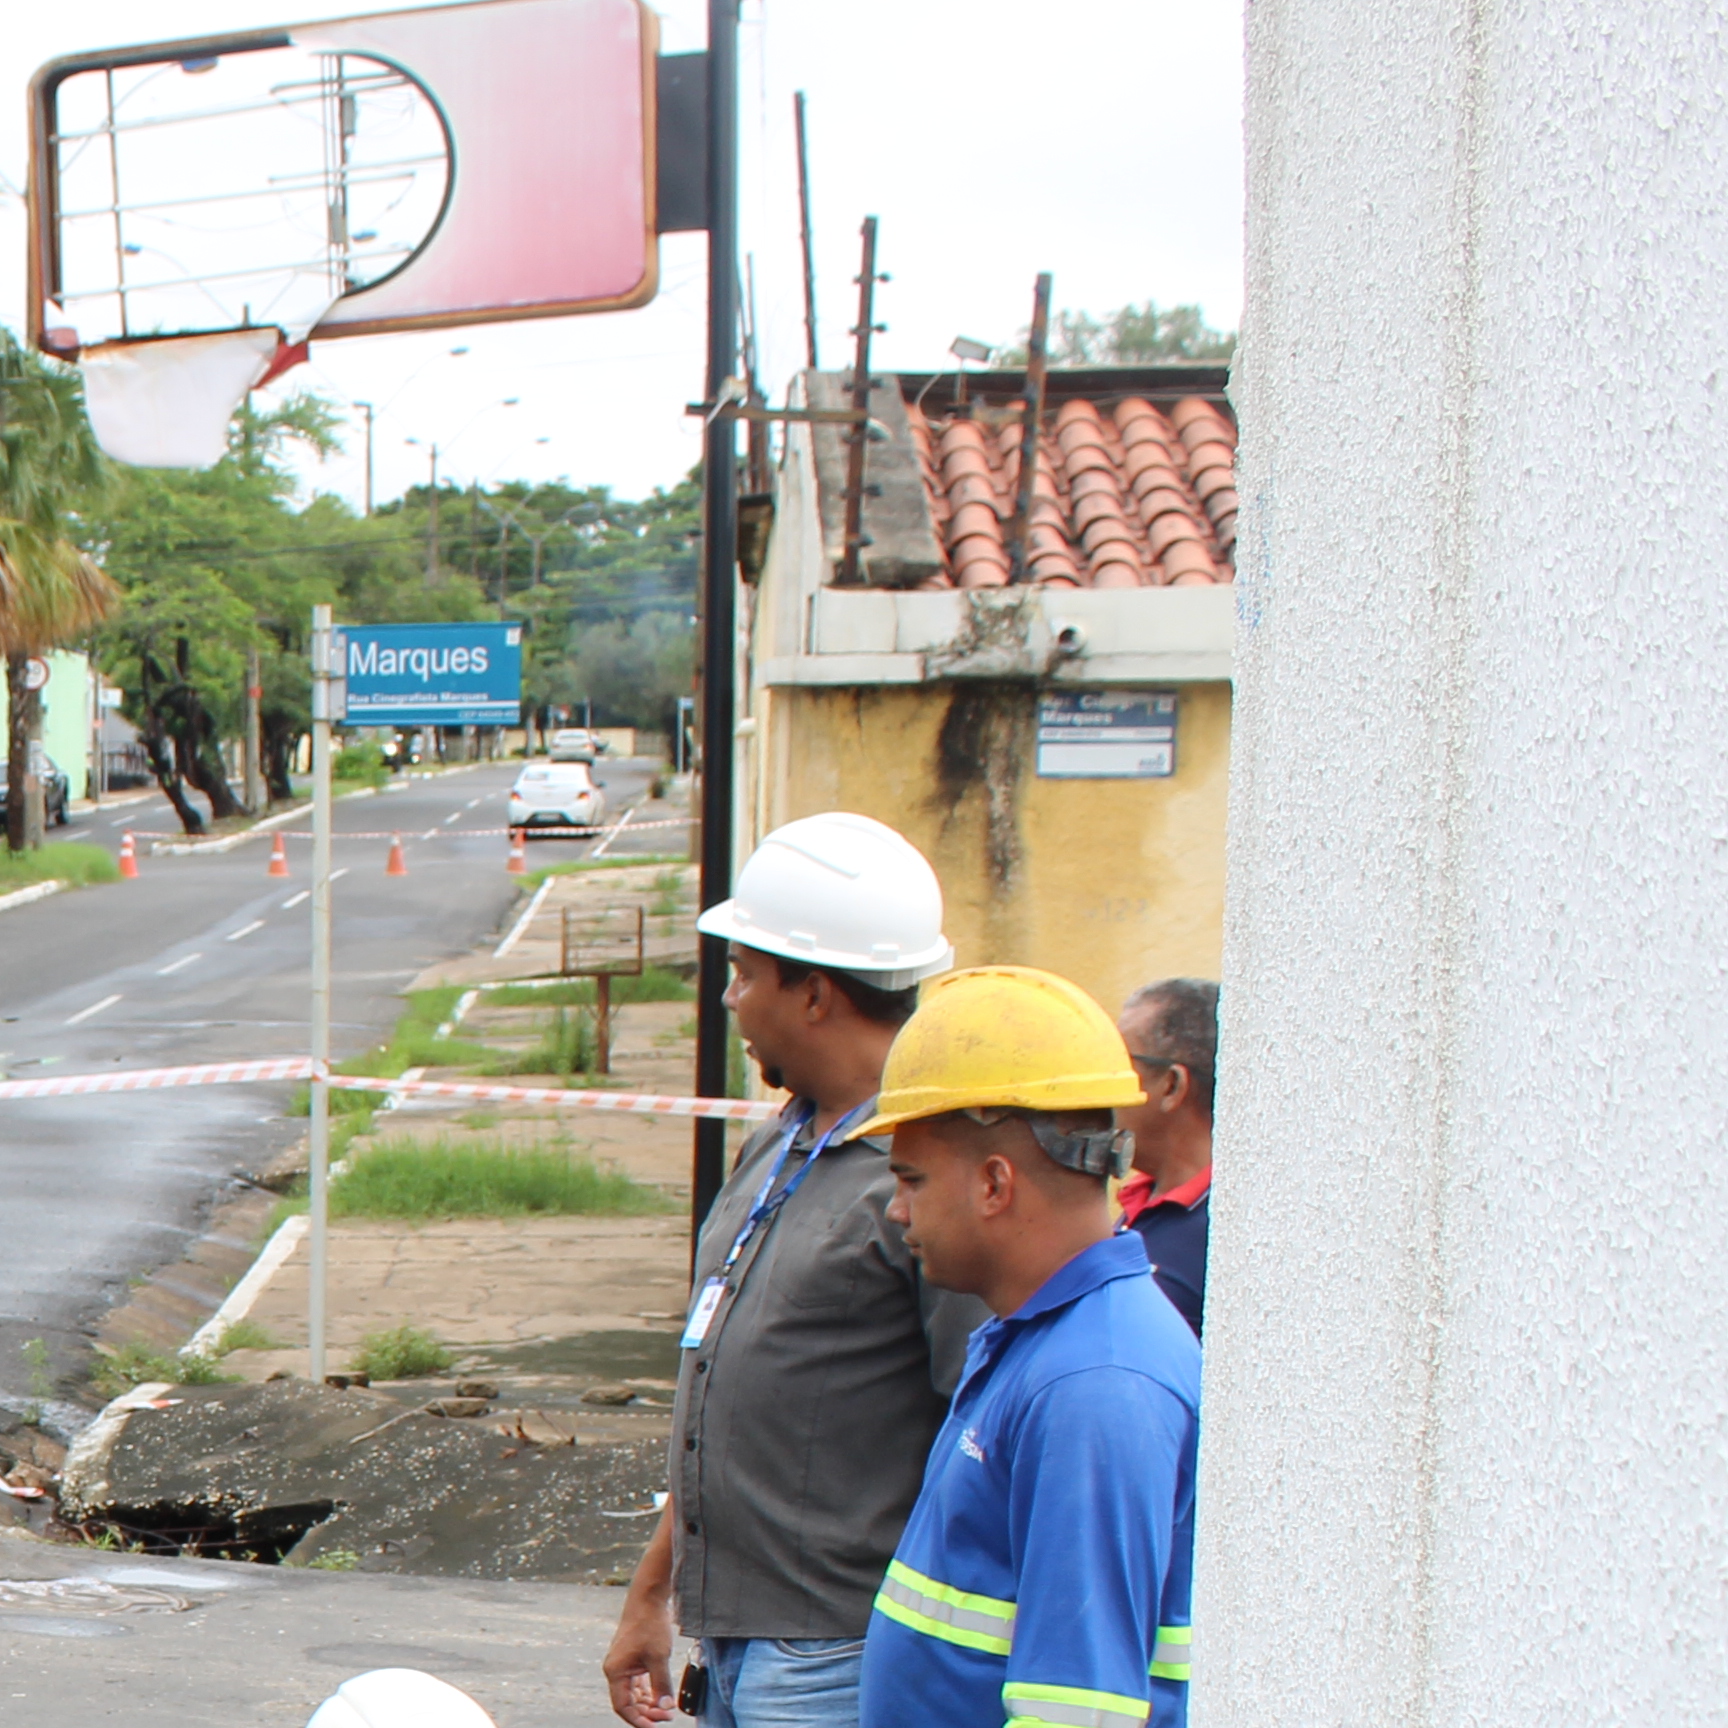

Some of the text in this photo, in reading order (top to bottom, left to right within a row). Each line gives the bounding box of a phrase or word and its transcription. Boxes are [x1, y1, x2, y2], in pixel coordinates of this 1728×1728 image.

[349, 641, 489, 683] Marques
[347, 692, 370, 704] Rua
[440, 691, 489, 704] Marques
